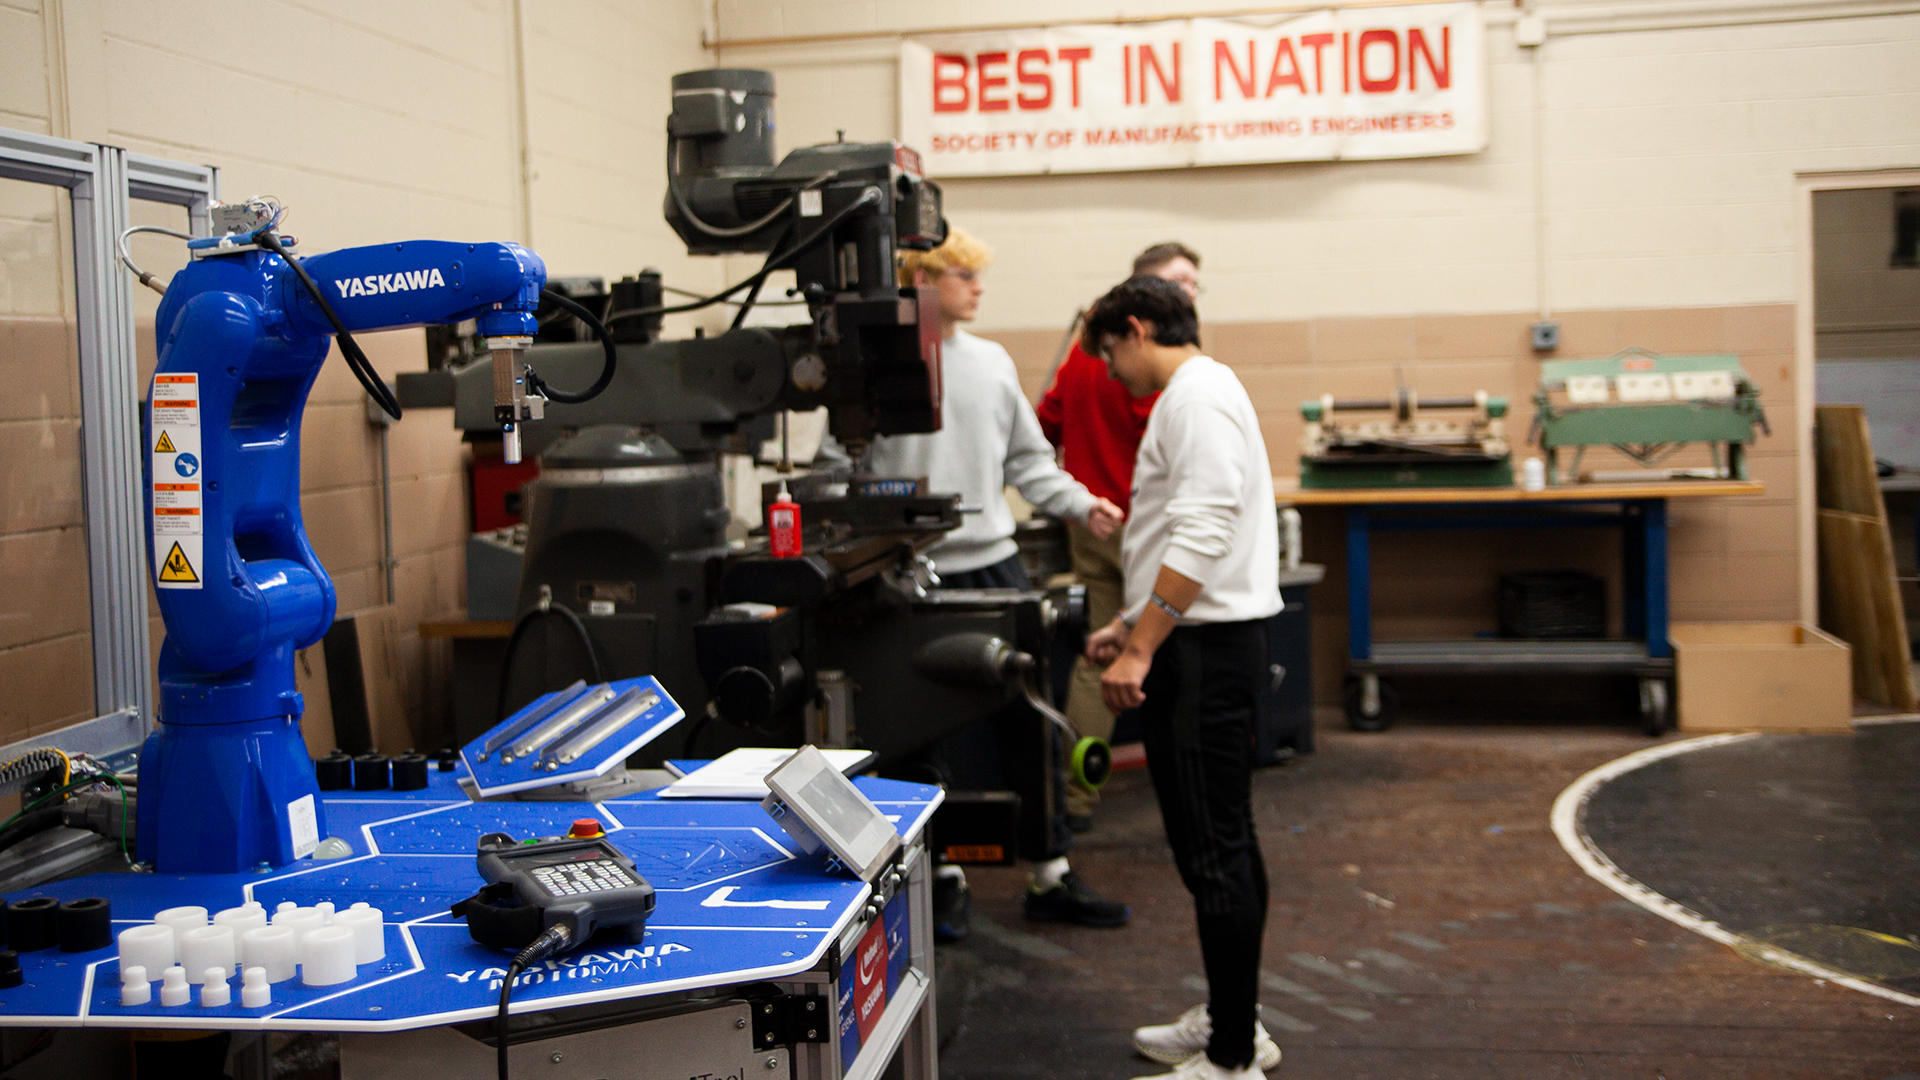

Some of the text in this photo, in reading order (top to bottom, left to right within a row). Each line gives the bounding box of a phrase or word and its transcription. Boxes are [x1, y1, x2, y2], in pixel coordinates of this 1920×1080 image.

[933, 26, 1452, 115] BEST IN NATION
[931, 111, 1454, 153] SOCIETY OF MANUFACTURING ENGINEERS
[335, 267, 446, 299] YASKAWA
